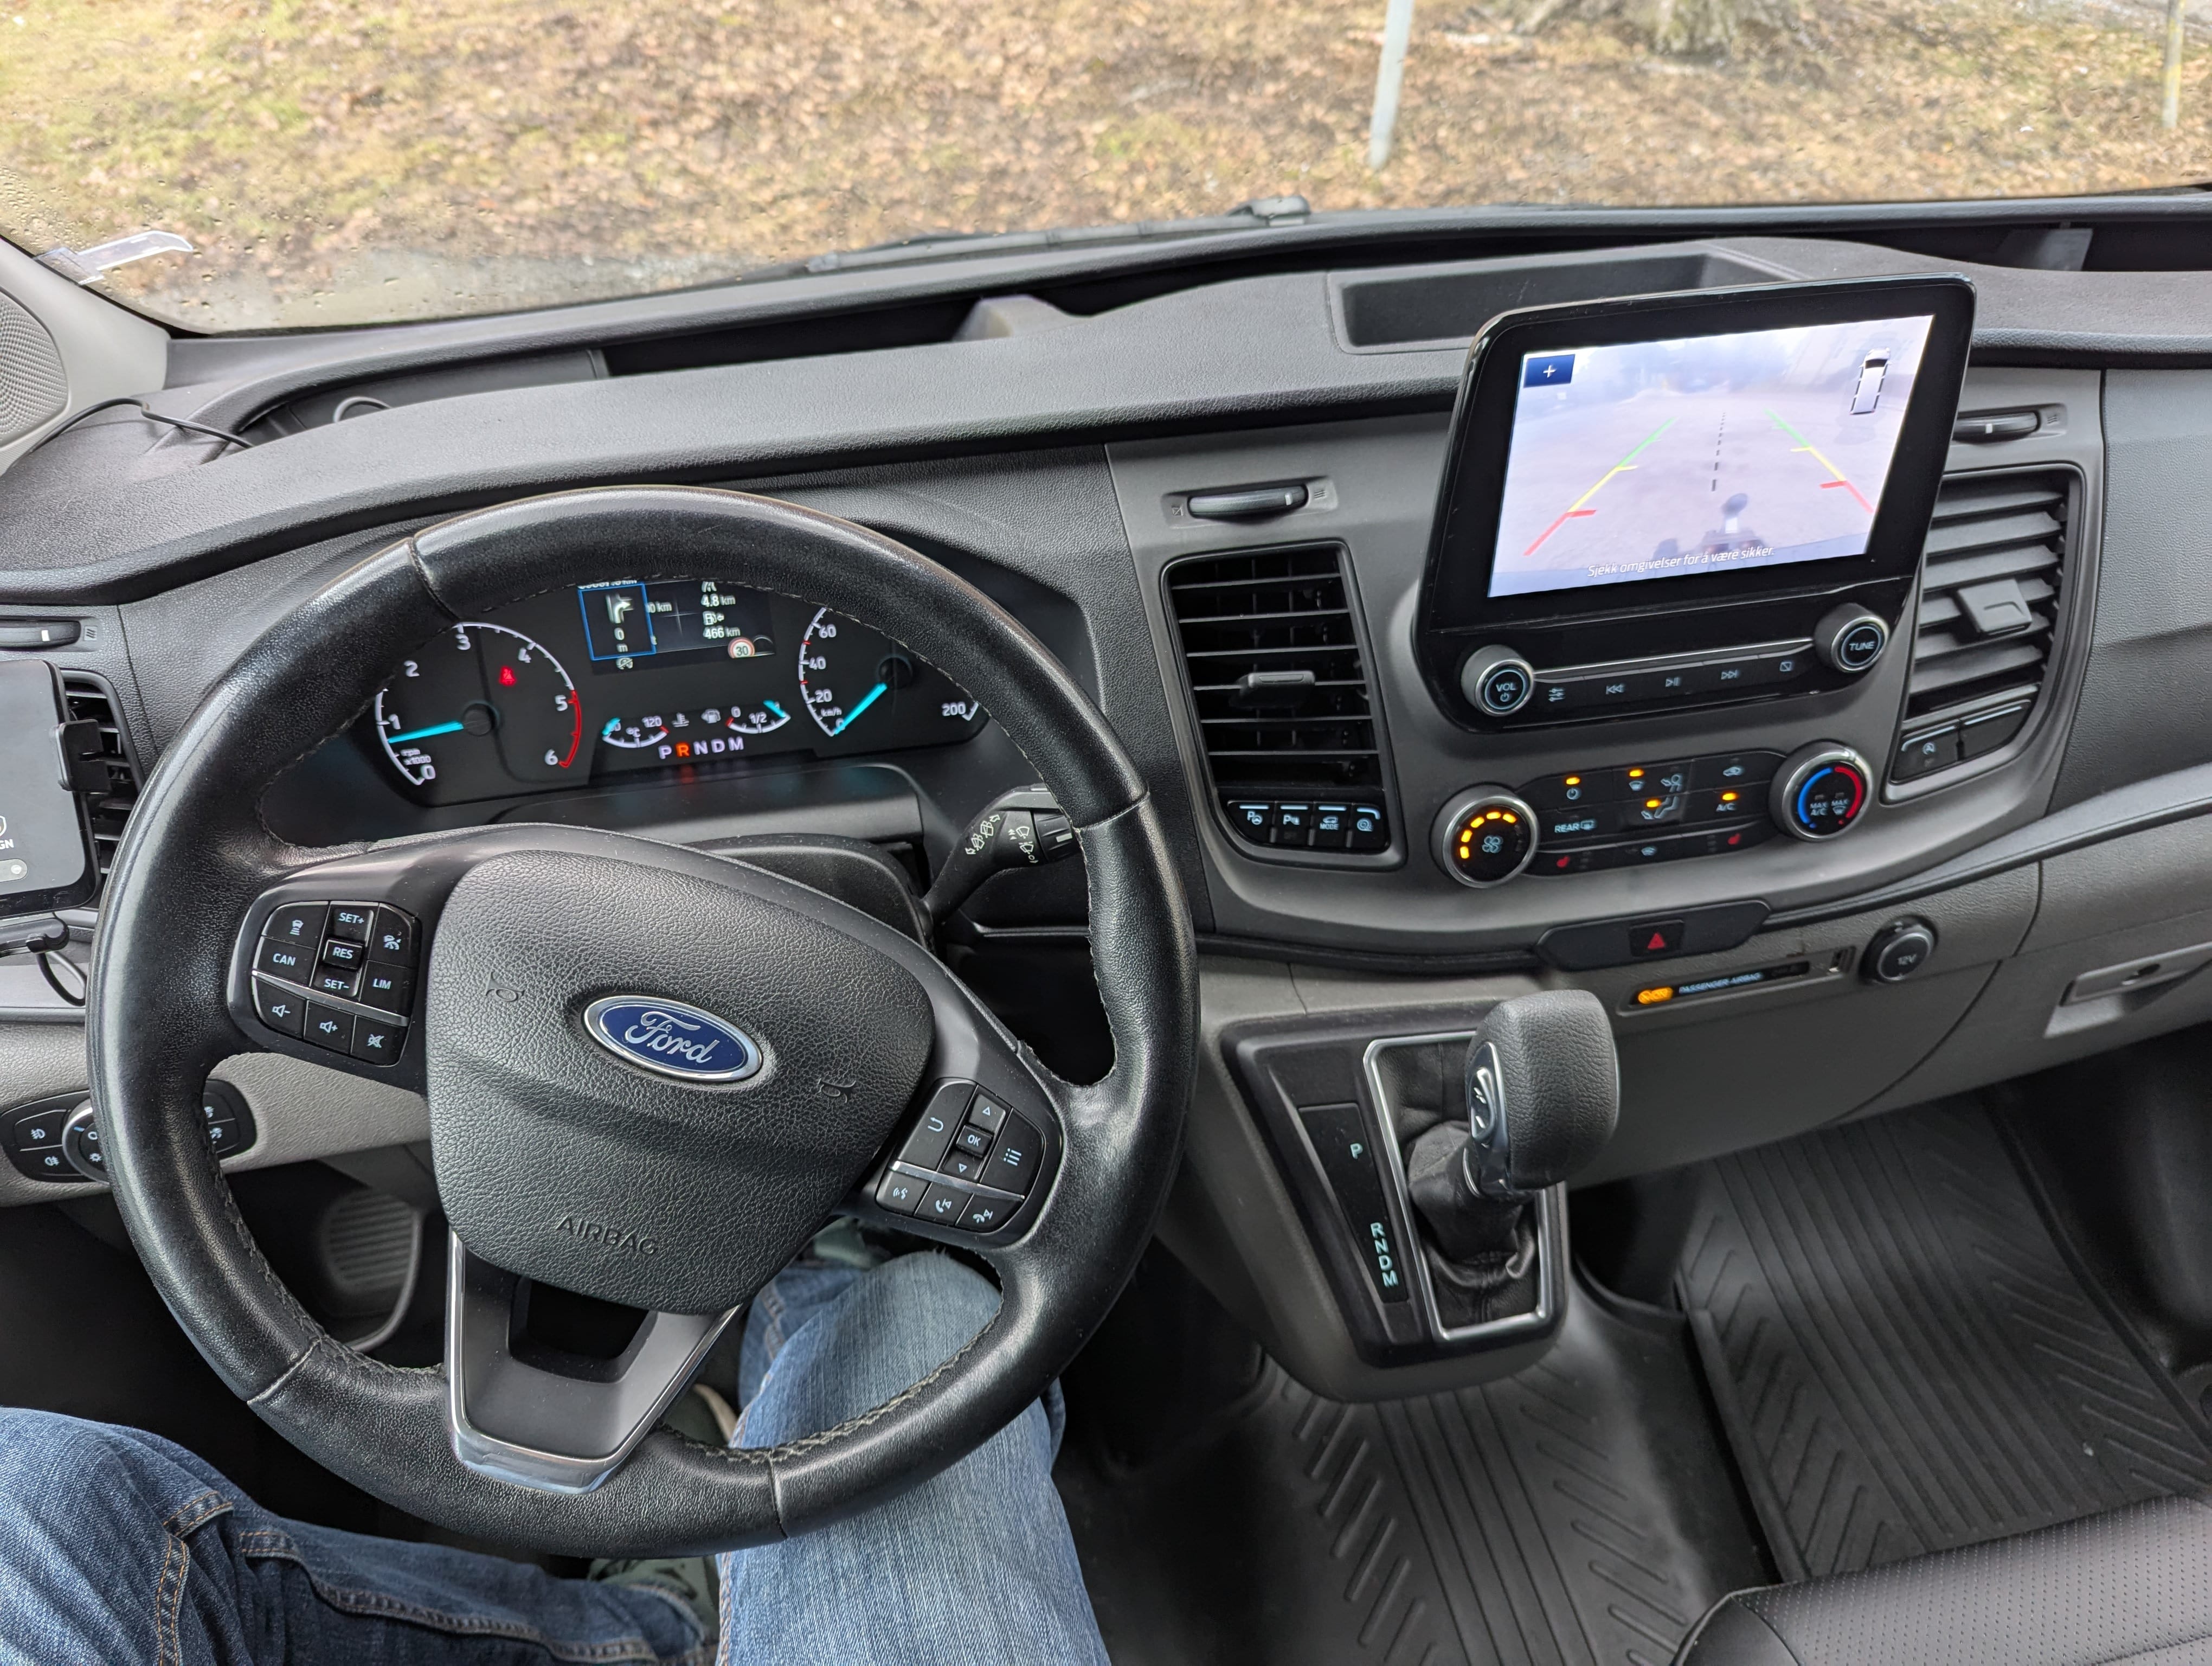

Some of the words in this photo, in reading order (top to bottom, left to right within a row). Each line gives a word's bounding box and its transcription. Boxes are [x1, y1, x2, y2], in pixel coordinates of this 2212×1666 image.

[1587, 563, 1618, 578] Sjekk
[1619, 557, 1681, 573] omgivelser
[1683, 553, 1699, 565] for
[1701, 551, 1709, 564] å
[1711, 552, 1739, 563] være
[1740, 546, 1775, 560] sikker.
[655, 601, 672, 612] km
[700, 593, 720, 607] 4.8
[719, 594, 736, 606] km
[703, 625, 725, 639] 466
[724, 626, 741, 638] km
[818, 624, 837, 639] 60
[455, 633, 471, 651] 3
[616, 643, 628, 652] m
[1849, 641, 1875, 652] TUNE
[518, 648, 532, 663] 4
[736, 645, 748, 656] 30
[403, 659, 420, 677] 2
[809, 656, 827, 670] 40
[1496, 682, 1517, 693] VOL
[555, 694, 569, 712] 5
[814, 689, 832, 703] 20
[731, 706, 741, 719] 0
[820, 707, 842, 717] km/h
[941, 701, 967, 717] 200
[388, 714, 401, 730] 1
[641, 716, 663, 728] 120
[749, 712, 768, 725] 1/2
[658, 745, 672, 759] P
[676, 742, 690, 757] R
[693, 740, 708, 755] N
[711, 738, 725, 753] D
[728, 736, 744, 751] M
[544, 749, 559, 766] 6
[420, 764, 436, 780] 0
[1716, 803, 1735, 812] A/C
[1811, 808, 1827, 816] A/C
[1554, 823, 1580, 834] REAR
[339, 912, 364, 924] SET+
[273, 953, 296, 966] CAN
[332, 947, 353, 959] RES
[1898, 954, 1917, 965] 12V
[324, 978, 350, 990] SET-
[372, 978, 391, 990] LIM
[625, 1011, 719, 1063] Ford
[967, 1134, 981, 1146] OK
[1350, 1143, 1363, 1159] P
[556, 1215, 660, 1255] AIRBAG
[1371, 1222, 1385, 1238] R
[1374, 1238, 1389, 1253] N
[1378, 1255, 1393, 1271] D
[1382, 1271, 1398, 1287] M
